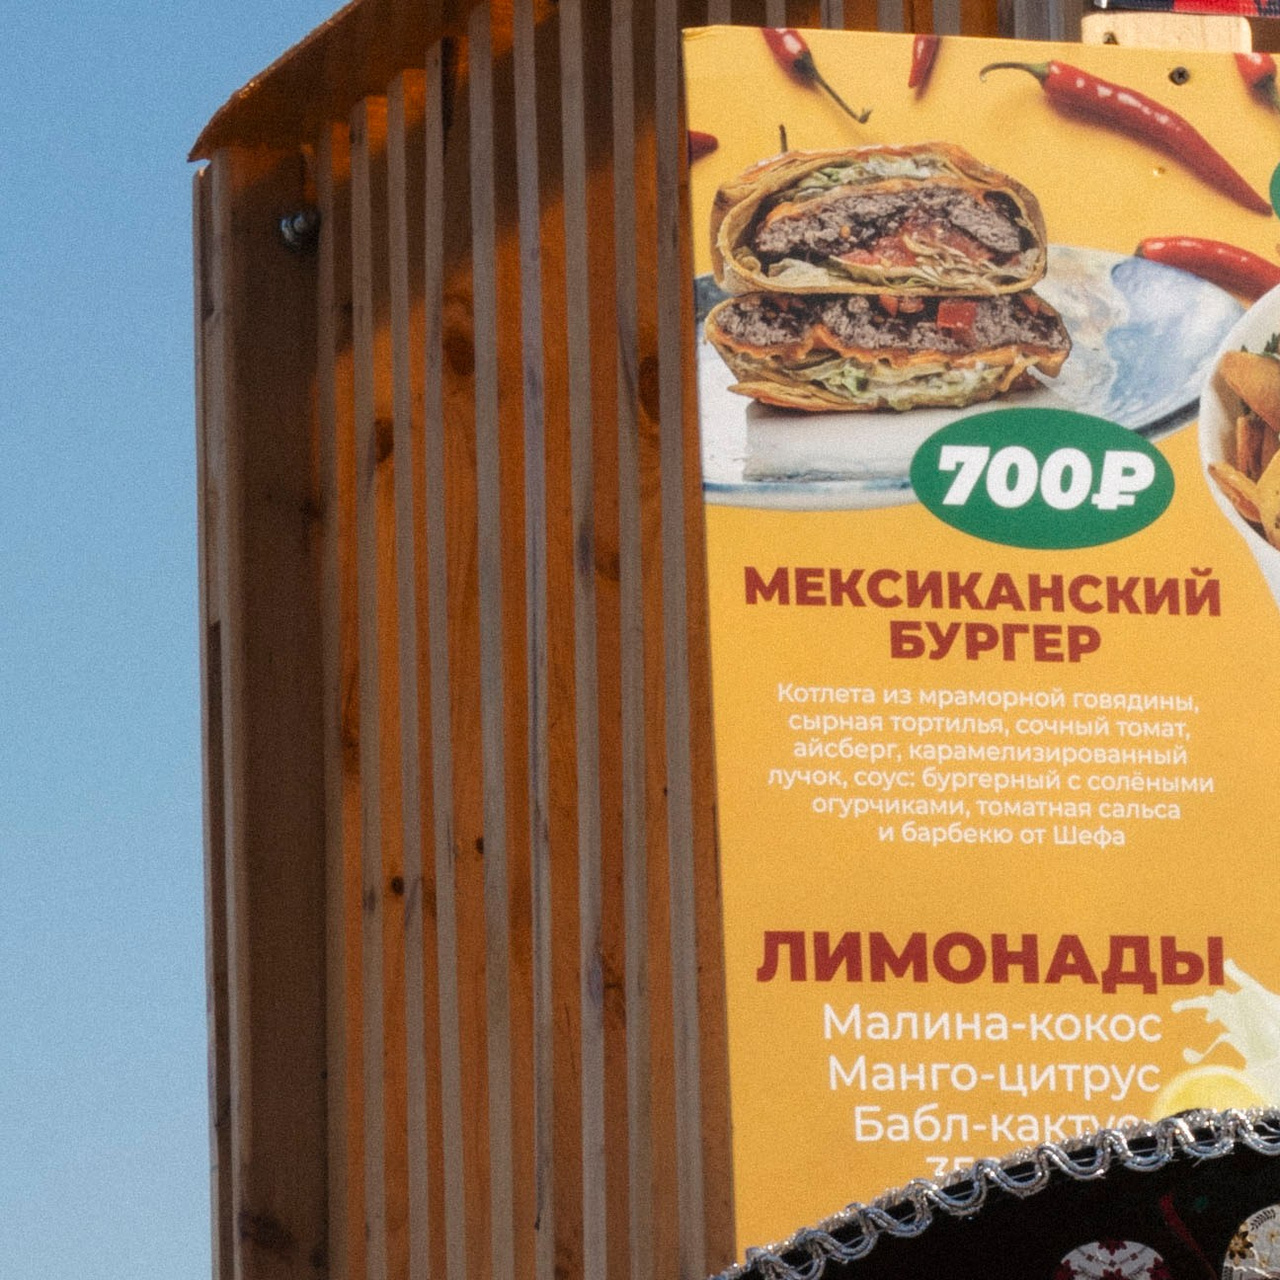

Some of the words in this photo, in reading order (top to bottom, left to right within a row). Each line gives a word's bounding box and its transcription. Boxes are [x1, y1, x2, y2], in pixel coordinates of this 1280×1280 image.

[744, 566, 1221, 617] МЕКСИКАНСКИЙ
[890, 620, 1101, 663] БУРГЕР
[777, 682, 876, 705] Котлета
[882, 688, 913, 706] из
[918, 687, 1067, 712] мраморной
[1072, 691, 1200, 714] говядины,
[787, 713, 884, 736] сырная
[888, 714, 1010, 738] тортилья,
[1014, 715, 1110, 737] сочный
[1114, 719, 1191, 741] томат,
[792, 736, 902, 764] айсберг,
[908, 742, 1189, 767] карамелизированный
[767, 768, 849, 791] лучок,
[852, 769, 916, 792] соус:
[921, 765, 1062, 794] бургерный
[1066, 773, 1082, 791] с
[1086, 770, 1215, 794] солёными
[811, 796, 971, 819] огурчиками,
[975, 798, 1093, 819] томатная
[1097, 801, 1182, 820] сальса
[877, 825, 895, 842] и
[900, 819, 1014, 847] барбекю
[1018, 827, 1047, 845] от
[1052, 824, 1126, 850] Шефа
[756, 930, 1225, 995] ЛИМОНАДЫ
[823, 1002, 1163, 1043] Малина-кокос
[828, 1054, 1161, 1102] Манго-цитрус
